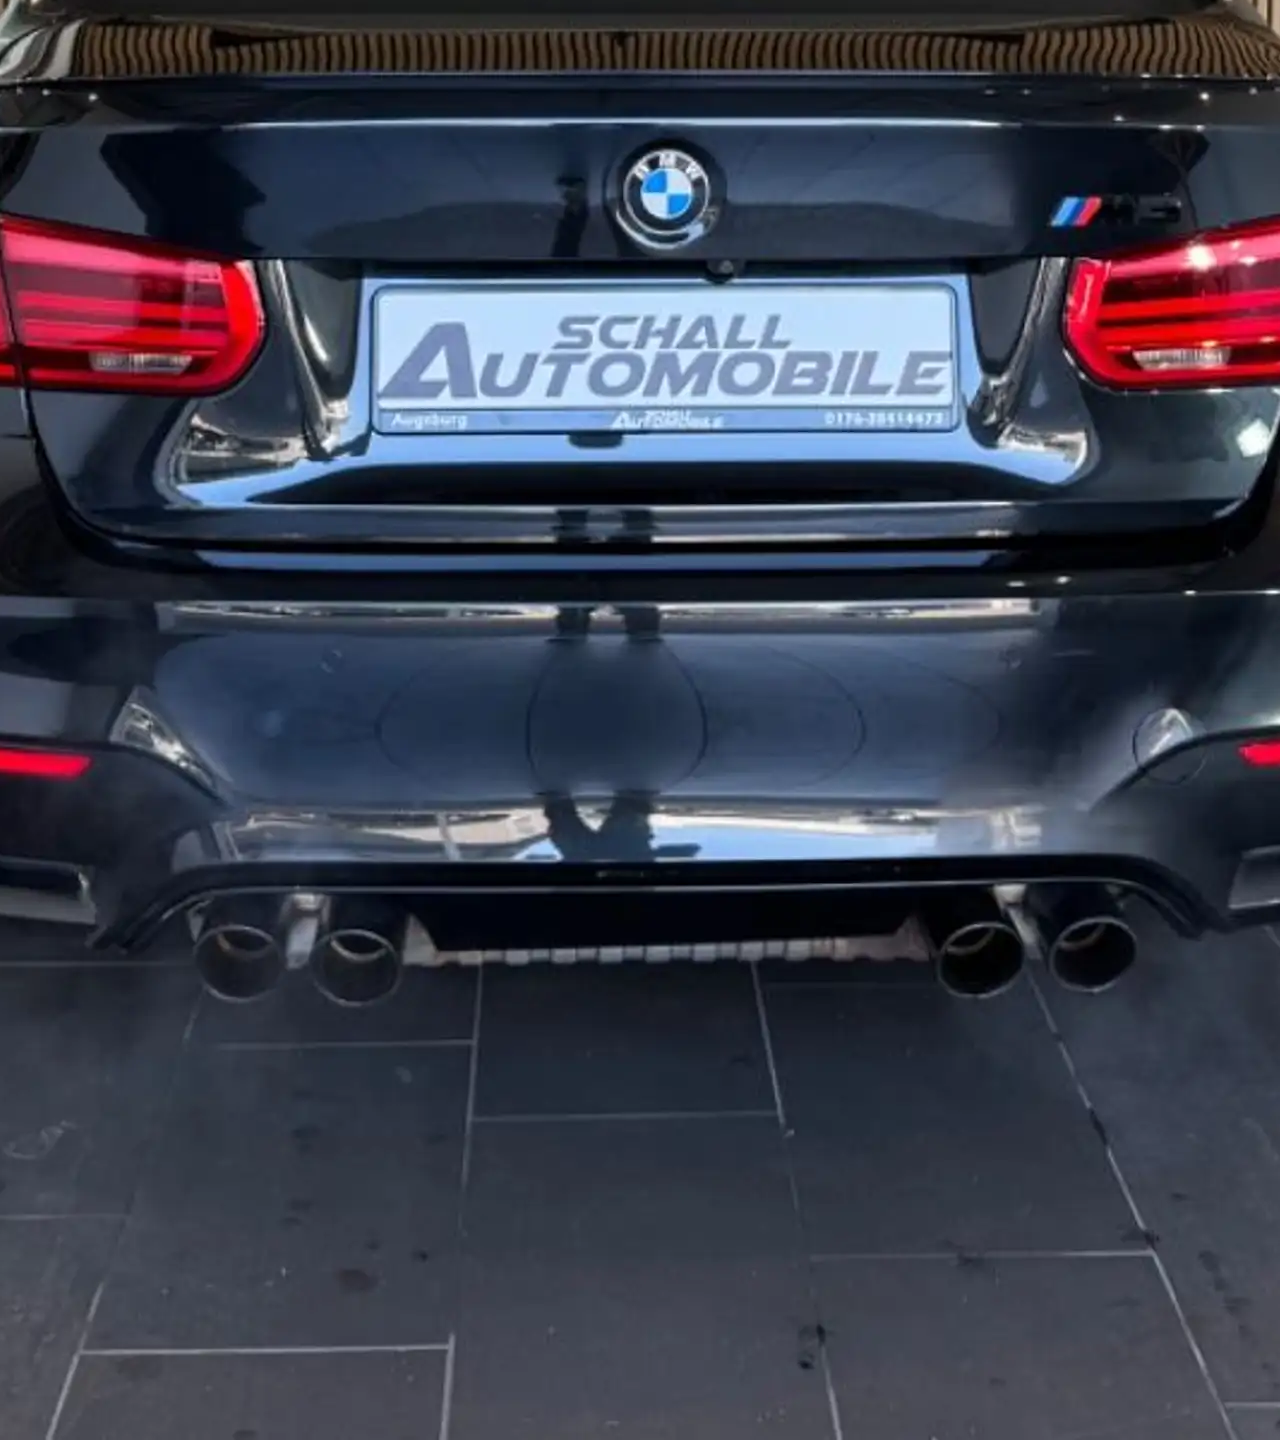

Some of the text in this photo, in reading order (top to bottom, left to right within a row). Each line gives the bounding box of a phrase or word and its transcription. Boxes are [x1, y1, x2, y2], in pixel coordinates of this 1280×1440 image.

[634, 152, 702, 181] BMW
[551, 314, 792, 350] SCHALL
[376, 321, 953, 398] AUTOMOBILE
